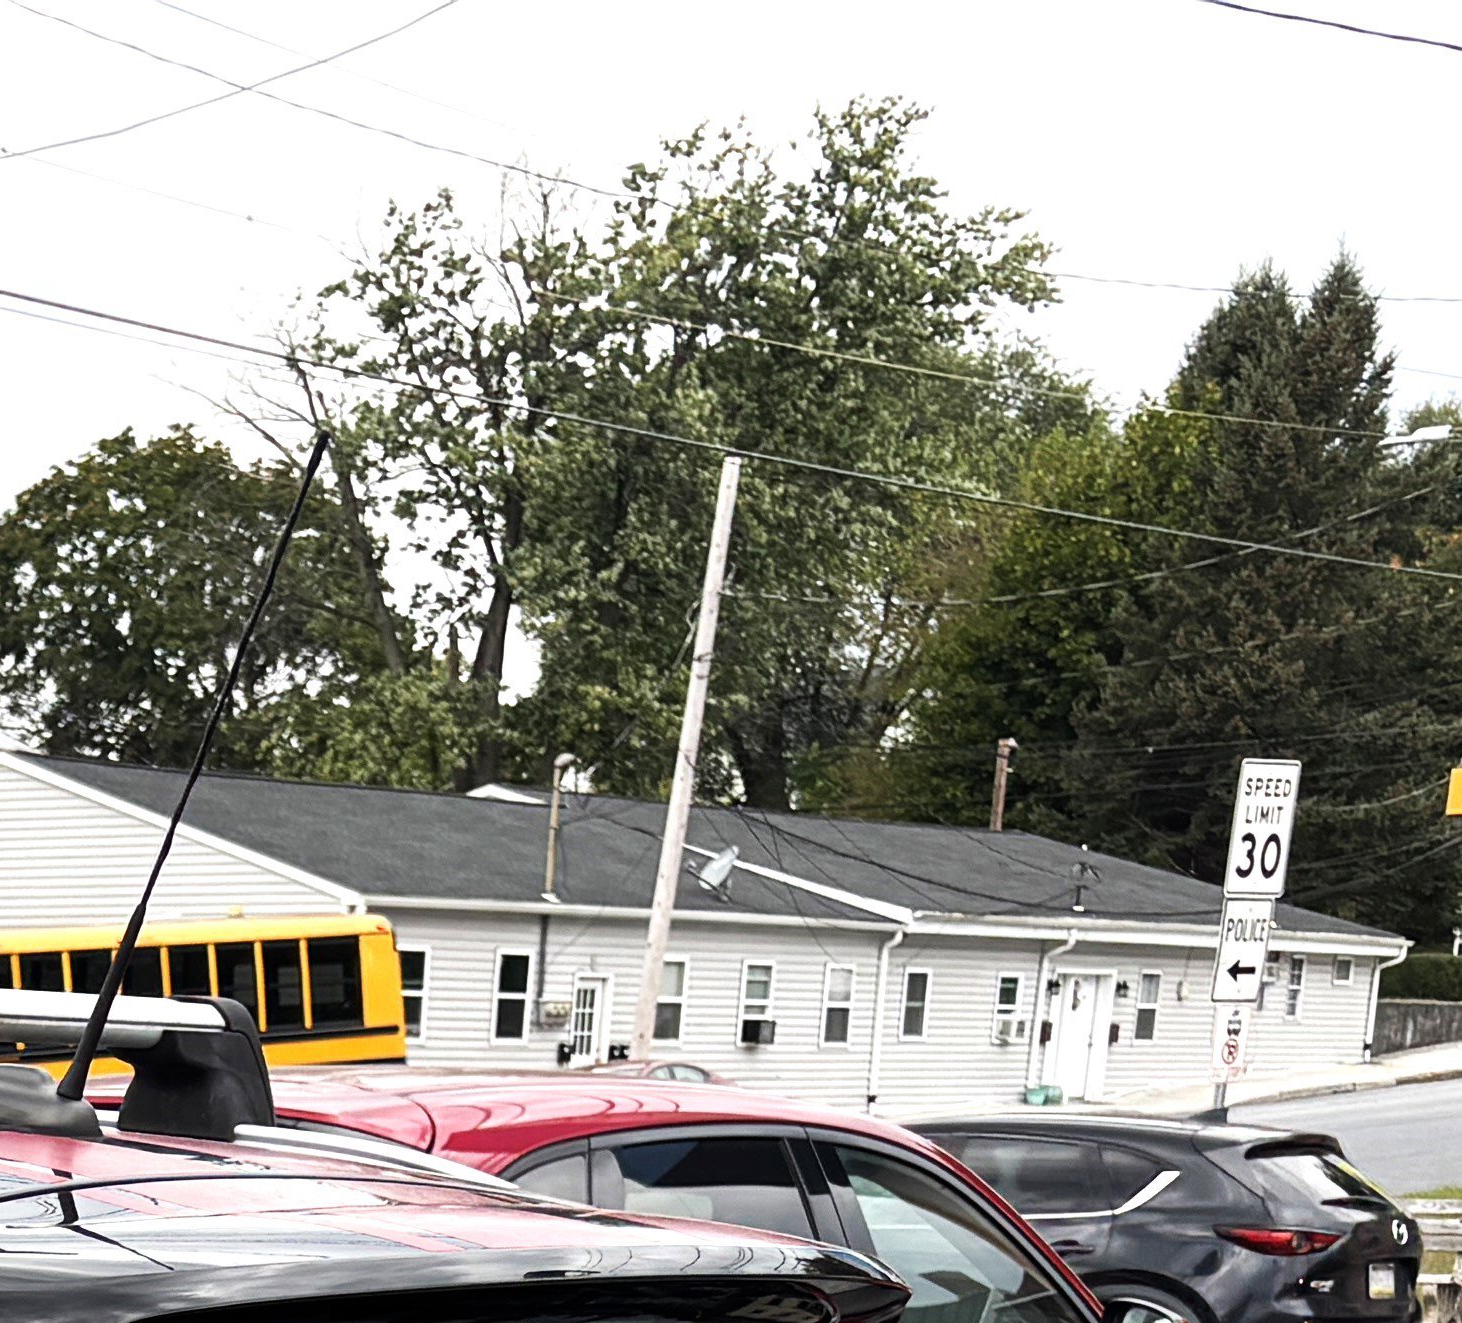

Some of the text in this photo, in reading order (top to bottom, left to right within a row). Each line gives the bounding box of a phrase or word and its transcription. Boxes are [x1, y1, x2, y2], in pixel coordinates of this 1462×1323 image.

[1244, 777, 1292, 798] SPEED
[1245, 806, 1284, 825] LIMIT
[1235, 832, 1282, 879] 30
[1225, 918, 1269, 942] POLICE
